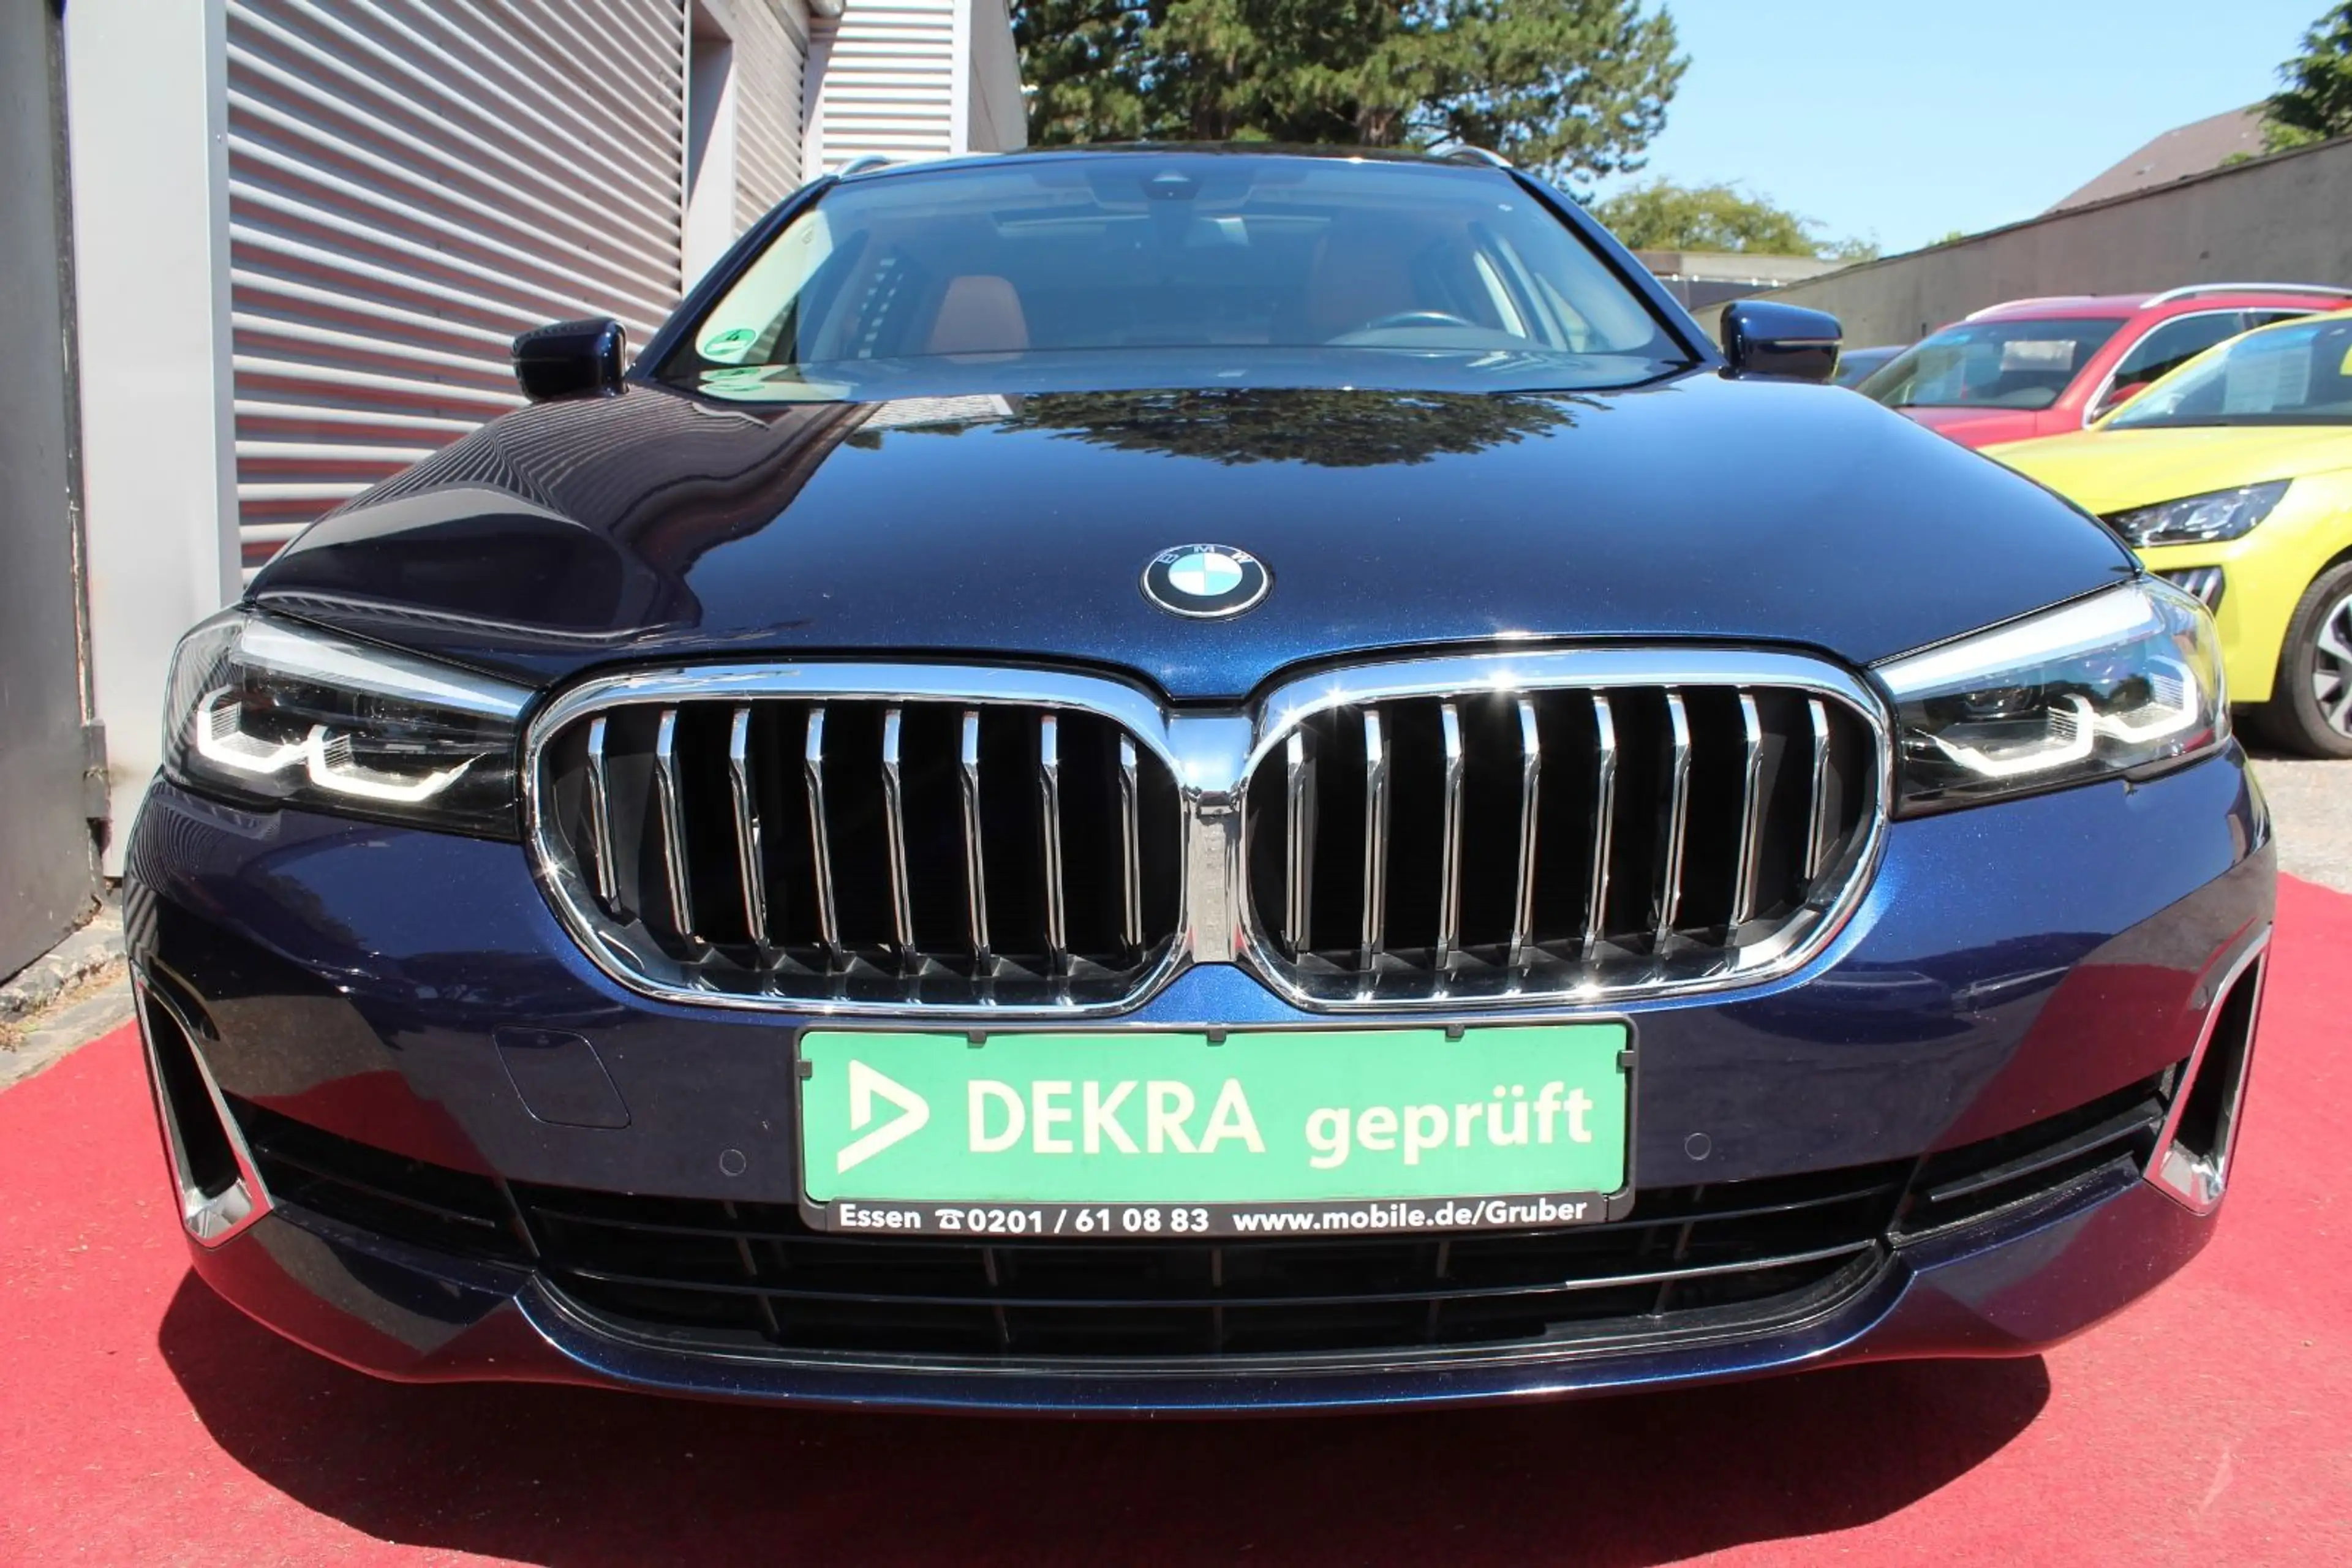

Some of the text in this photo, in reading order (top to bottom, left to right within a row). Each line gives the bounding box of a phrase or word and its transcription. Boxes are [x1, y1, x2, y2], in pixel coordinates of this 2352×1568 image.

[1158, 545, 1254, 564] BMW
[967, 1078, 1594, 1170] DEKRA geprüft
[839, 1203, 921, 1229] Essen
[967, 1208, 1042, 1234] 0201
[1074, 1208, 1110, 1232] 61
[1122, 1208, 1162, 1232] 08
[1170, 1208, 1209, 1232] 83
[1231, 1197, 1588, 1232] www.mobile.de/Gruber
